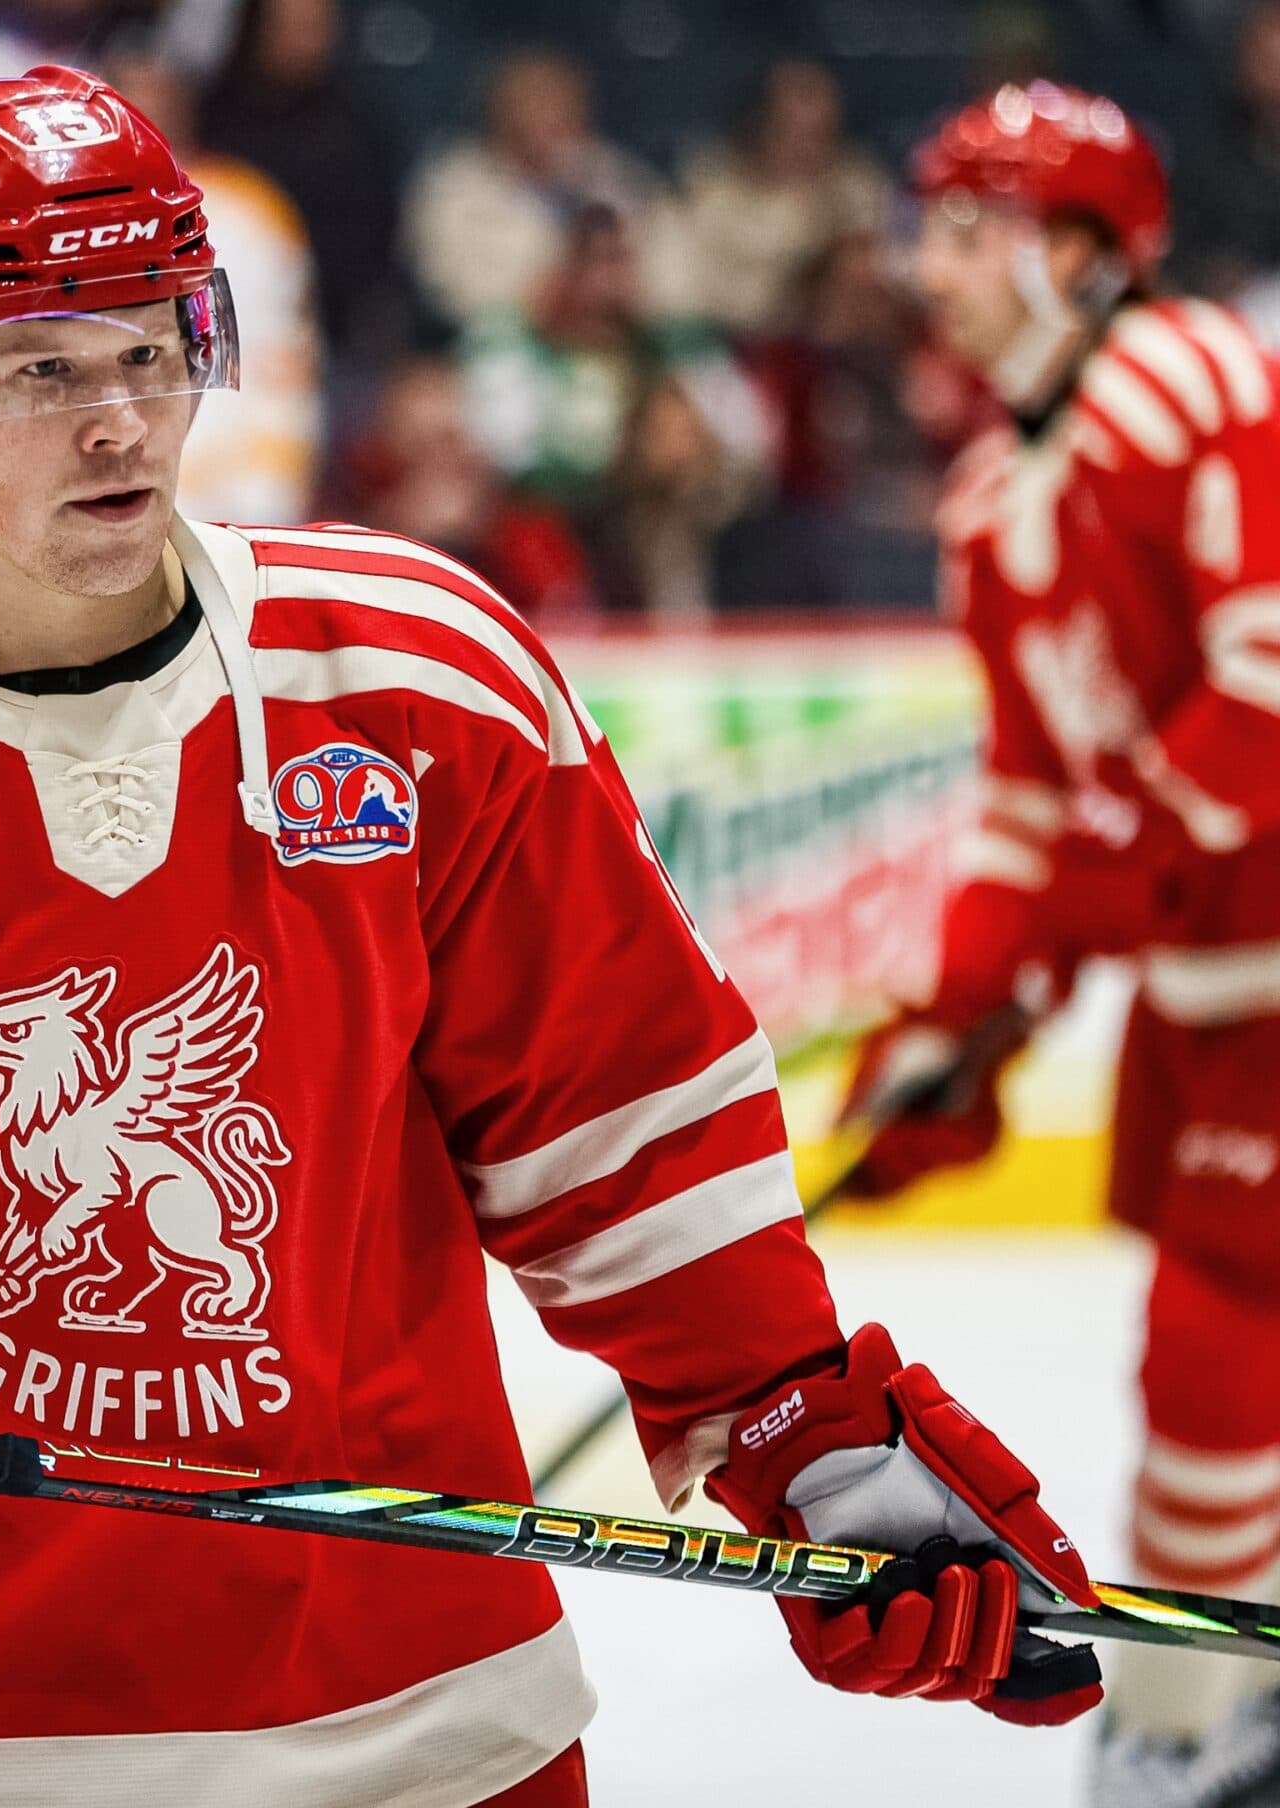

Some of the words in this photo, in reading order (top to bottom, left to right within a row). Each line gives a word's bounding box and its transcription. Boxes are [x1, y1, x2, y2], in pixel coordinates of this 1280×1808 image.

[15, 102, 104, 147] 15
[48, 218, 160, 255] CCM
[276, 762, 413, 834] 90
[300, 830, 339, 844] EST.
[740, 1389, 803, 1446] CCM
[765, 1418, 791, 1442] PRO
[61, 1487, 197, 1513] NEXUS
